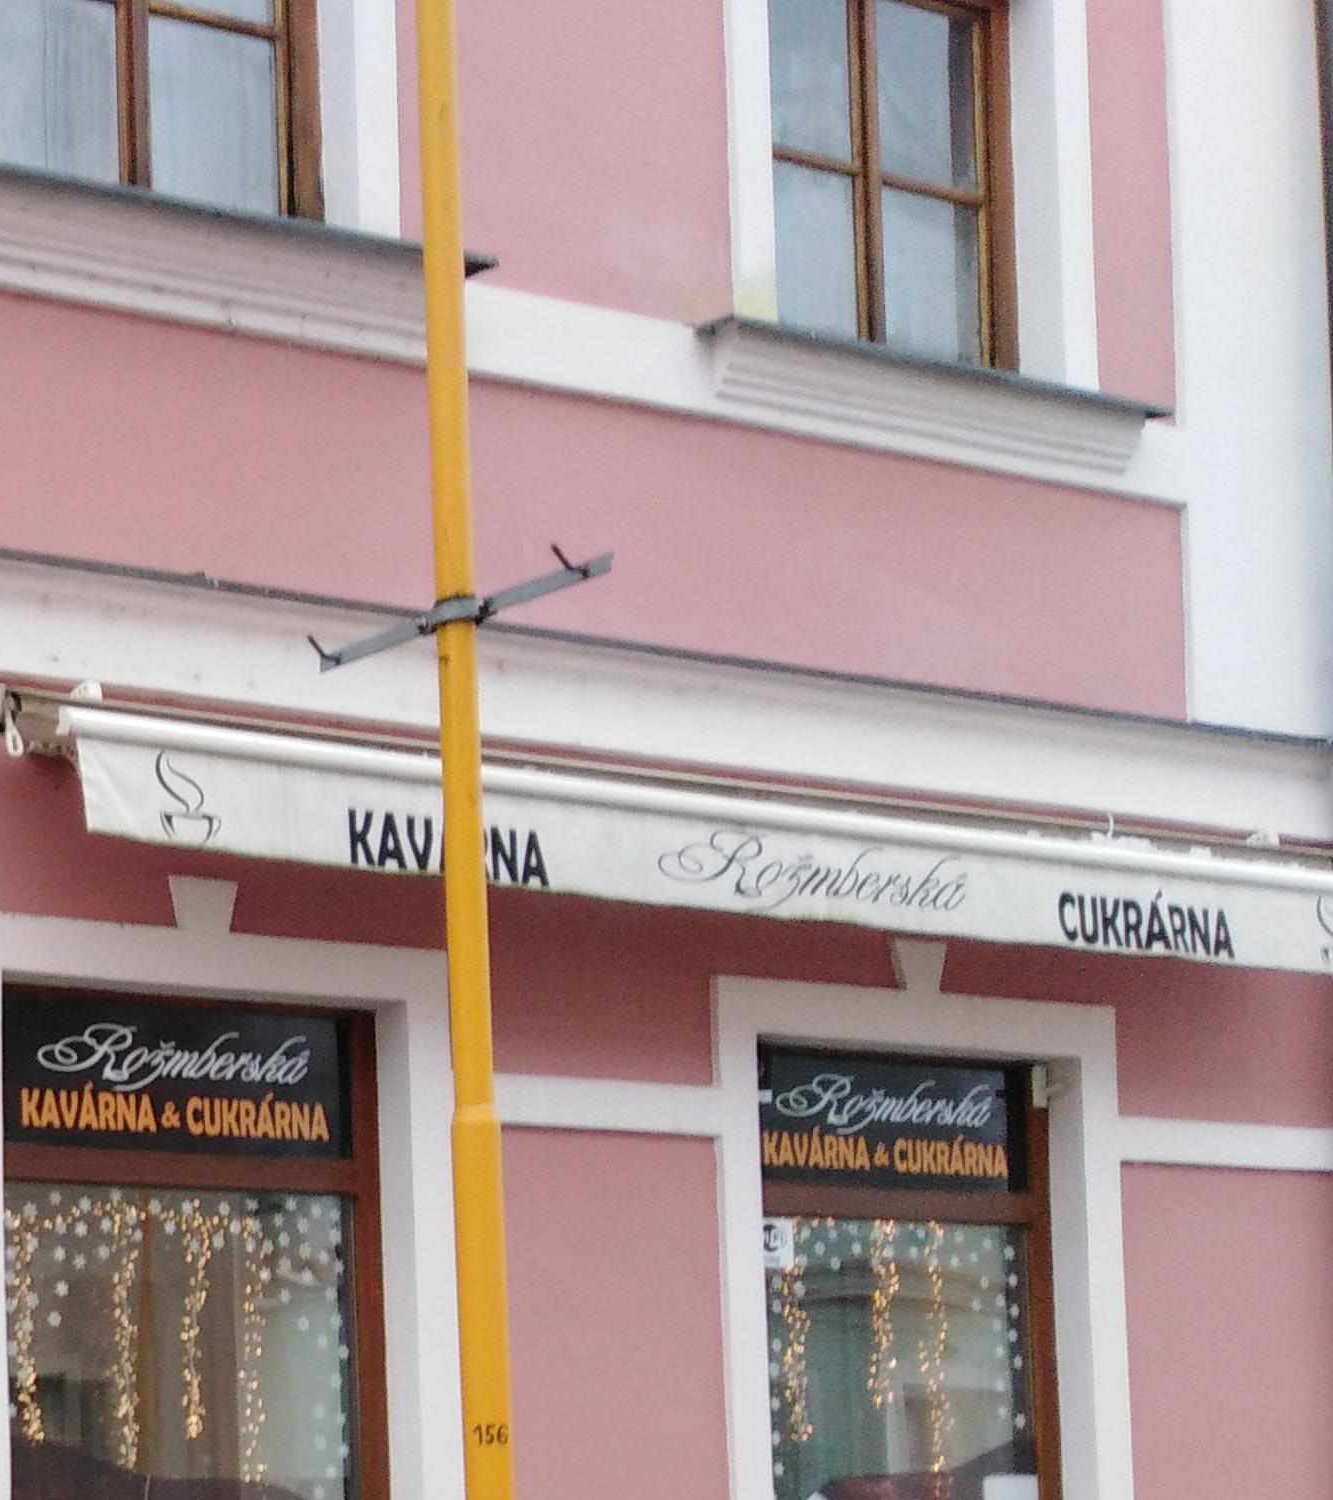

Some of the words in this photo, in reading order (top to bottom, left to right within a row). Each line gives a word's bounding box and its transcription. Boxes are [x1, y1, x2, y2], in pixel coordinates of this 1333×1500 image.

[348, 808, 550, 887] KAVNA
[657, 829, 968, 913] Rožmberská
[1057, 889, 1235, 960] CUKRÁRNA
[37, 1022, 311, 1092] Rožmberská
[20, 1080, 157, 1134] KAVÁRNA
[161, 1101, 181, 1129] &
[186, 1091, 330, 1142] CUKRÁRNA
[775, 1073, 995, 1135] Rožmberská
[762, 1125, 871, 1172] KAVÁRNA
[873, 1142, 889, 1168] &
[893, 1134, 1009, 1178] CUKRÁRNA
